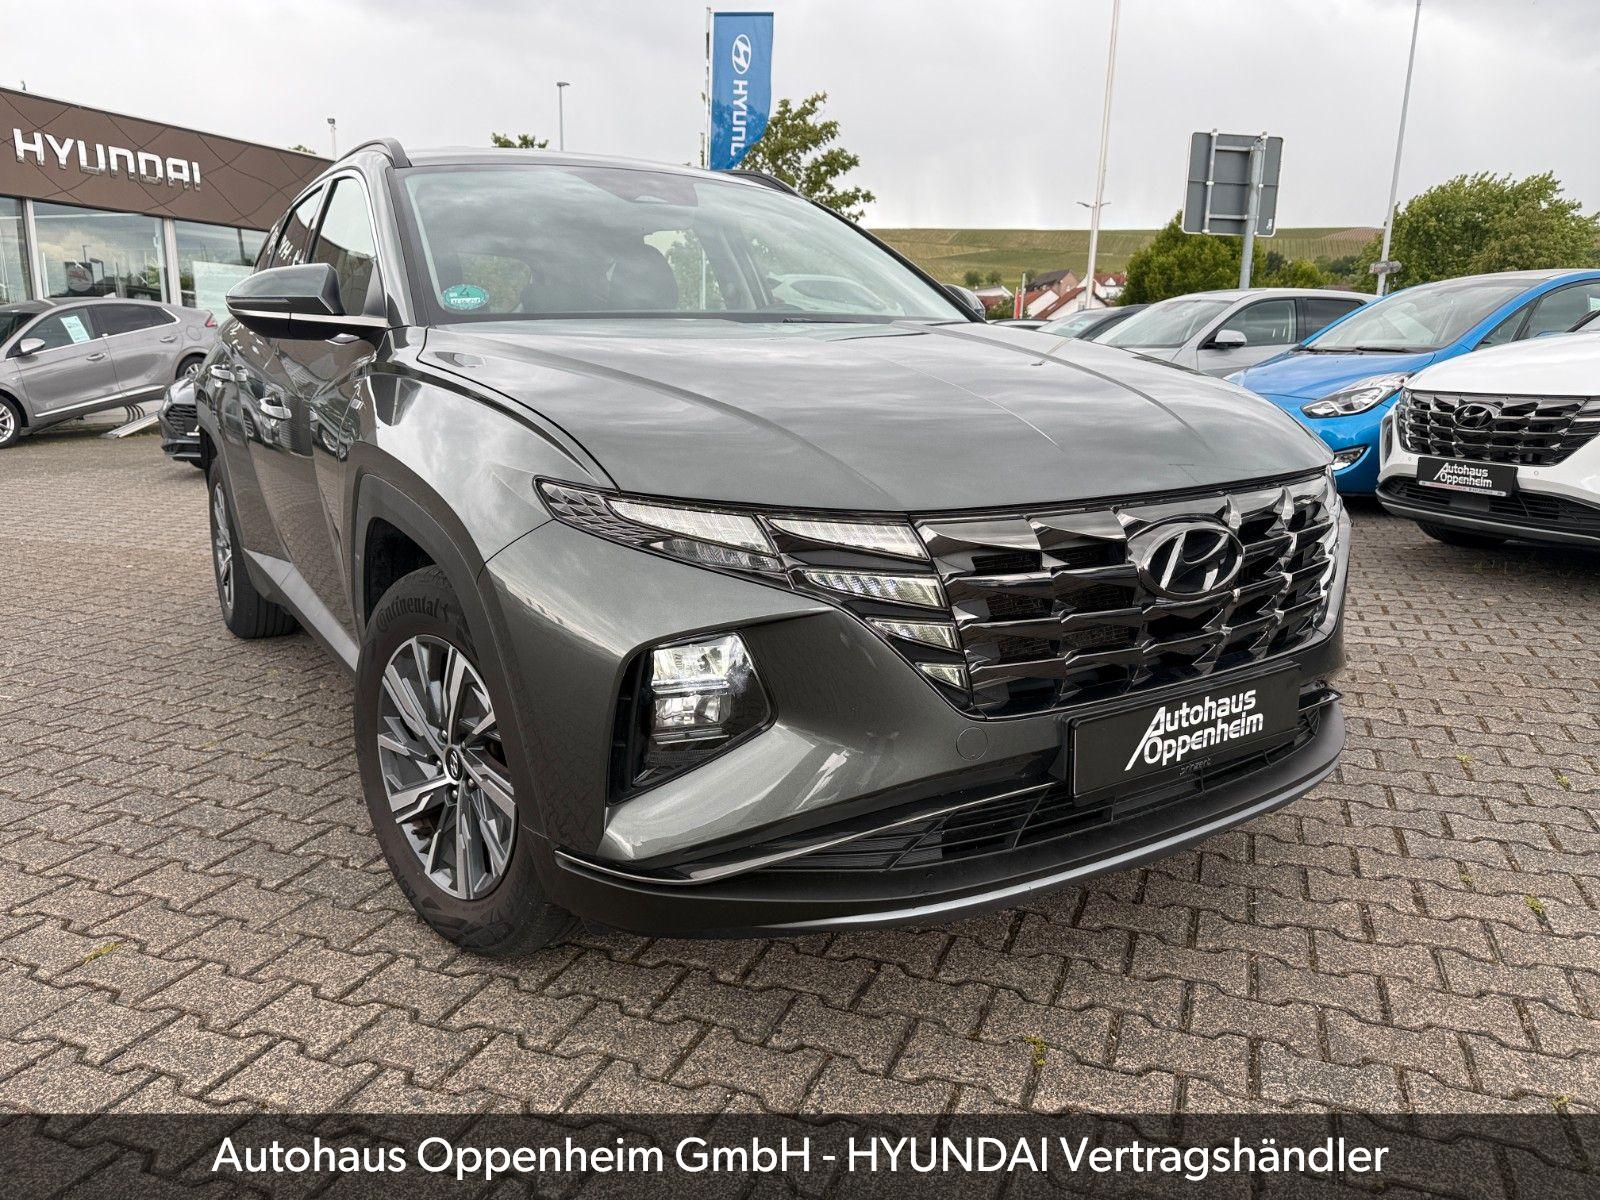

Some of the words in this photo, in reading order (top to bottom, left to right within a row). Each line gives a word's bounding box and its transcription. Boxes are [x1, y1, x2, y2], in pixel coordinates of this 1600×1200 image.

[12, 128, 202, 192] HYUNDAI
[1433, 462, 1489, 481] Autohaus
[1440, 472, 1493, 488] Oppenheim
[376, 596, 441, 633] Continental
[1124, 689, 1257, 772] Autohaus
[1143, 712, 1264, 766] Oppenheim
